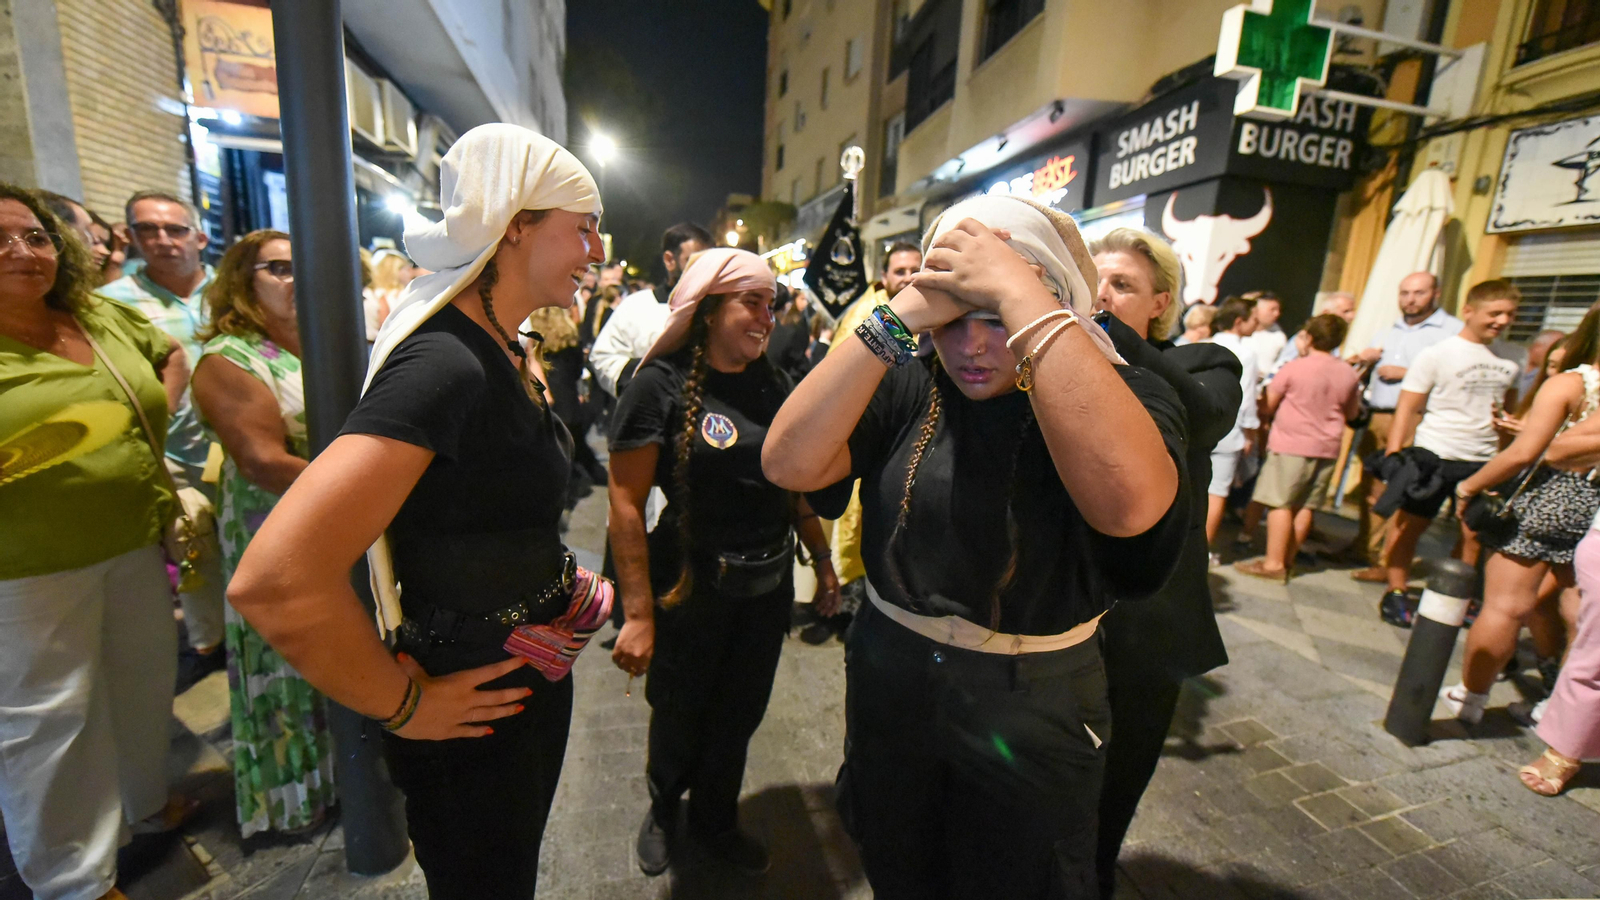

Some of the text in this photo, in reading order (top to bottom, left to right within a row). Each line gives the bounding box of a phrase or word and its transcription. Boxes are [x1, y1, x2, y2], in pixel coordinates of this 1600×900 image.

[1116, 99, 1199, 159] SMASH
[1290, 93, 1357, 133] ASH
[1108, 135, 1198, 190] BURGER
[1238, 121, 1353, 171] BURGER
